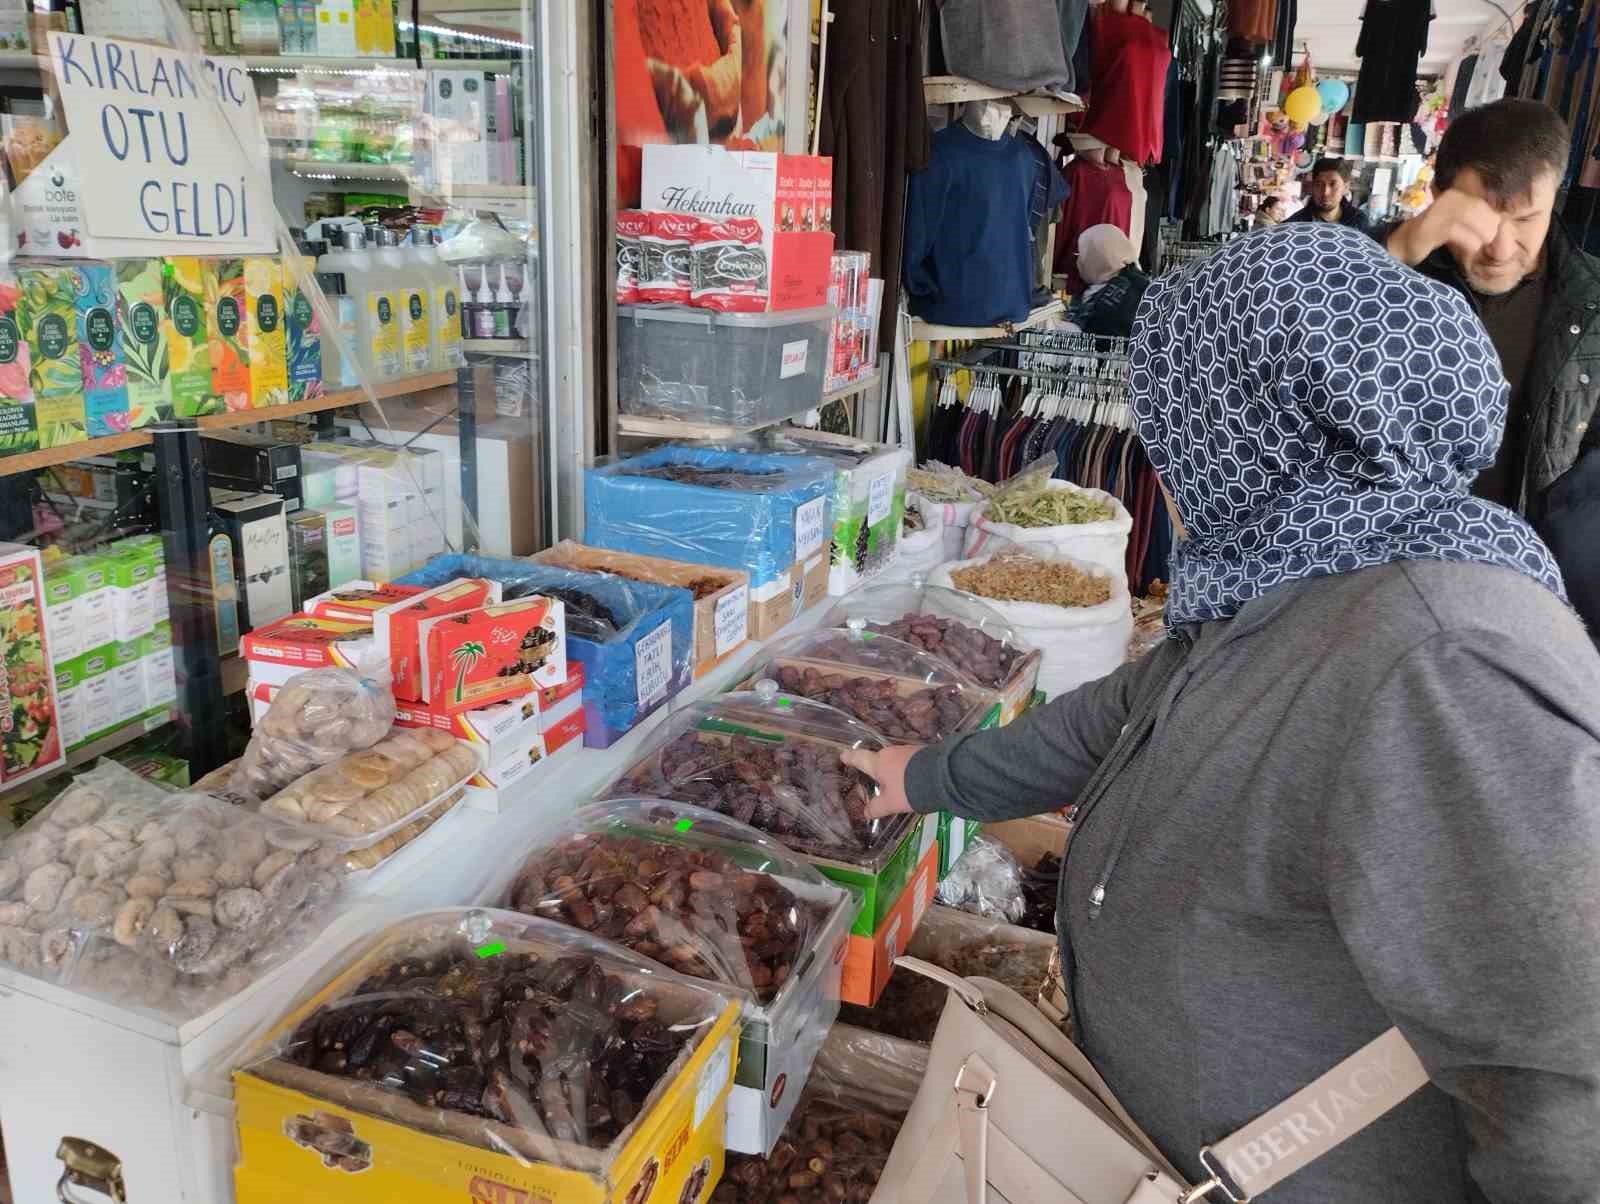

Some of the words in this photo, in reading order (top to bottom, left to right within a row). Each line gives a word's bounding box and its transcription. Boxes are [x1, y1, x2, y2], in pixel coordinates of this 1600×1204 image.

[57, 36, 246, 106] KIRLANIÇ
[102, 104, 189, 166] OTU
[140, 177, 249, 237] GELDİ
[662, 186, 758, 216] Hekimhan
